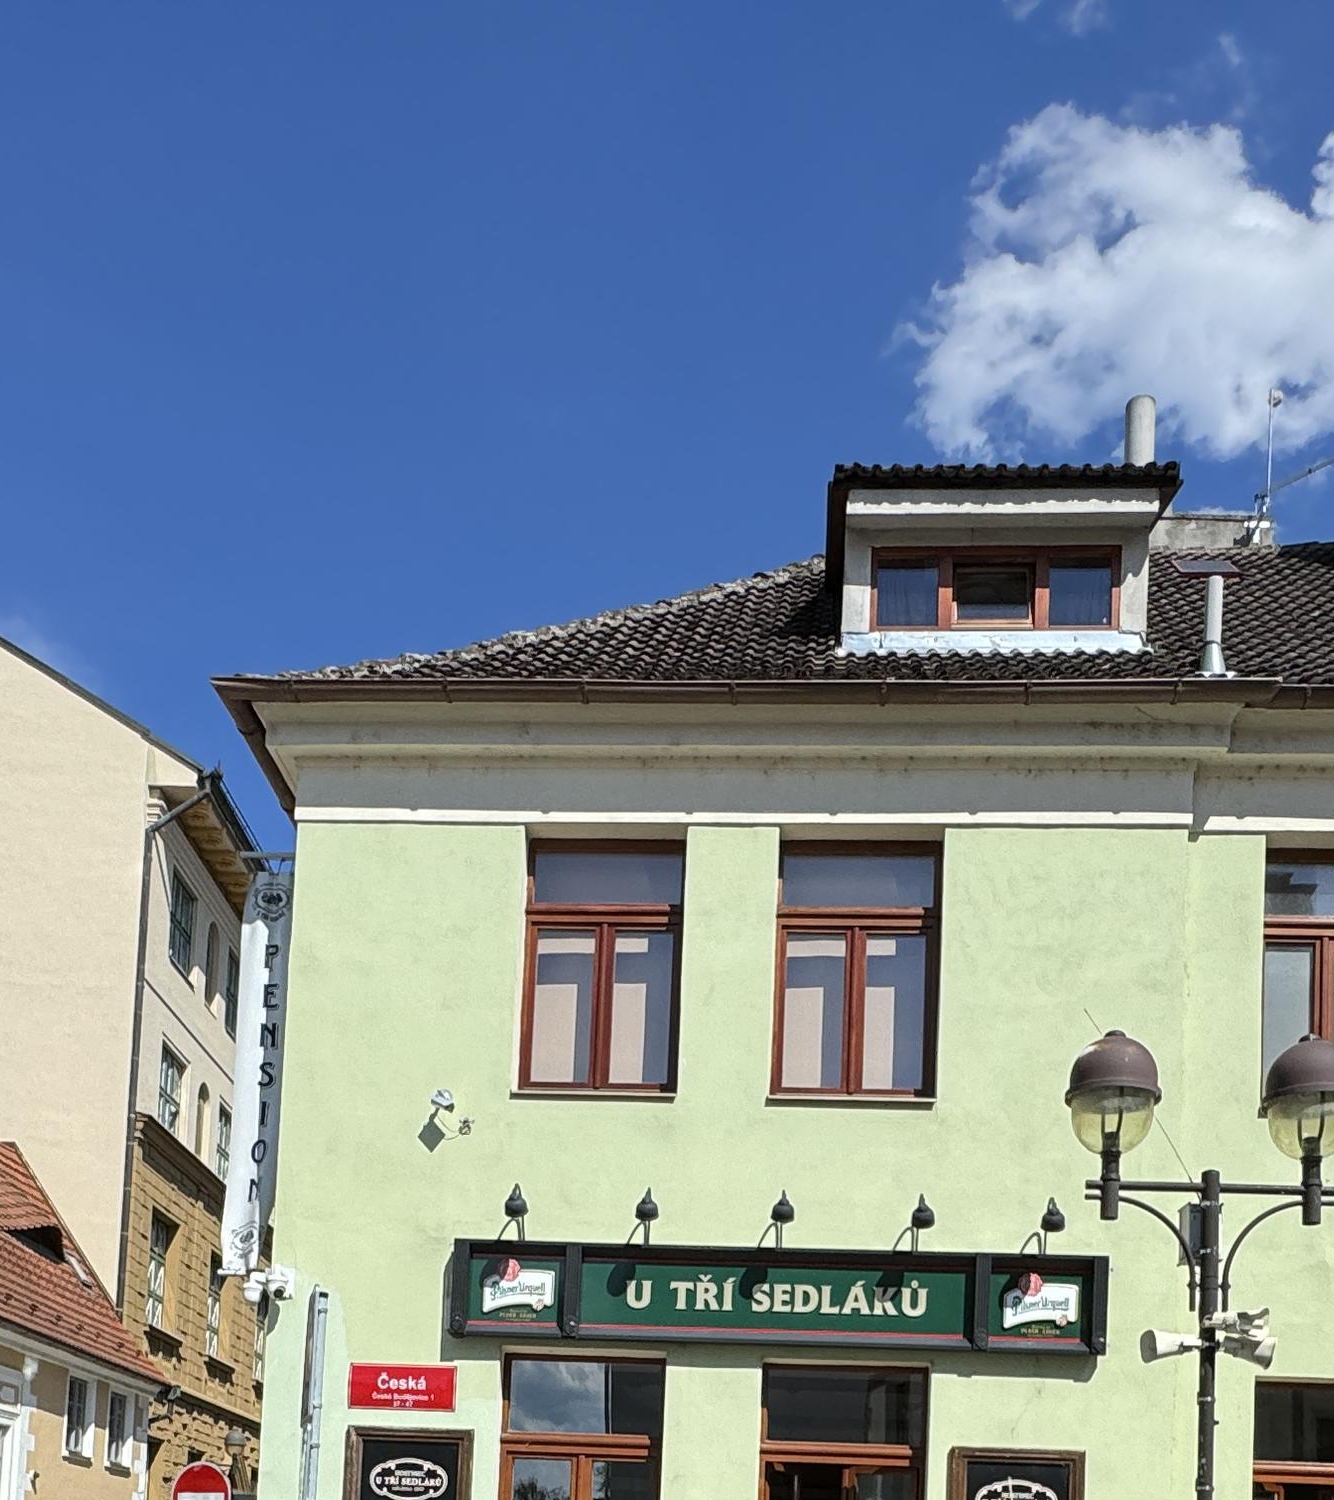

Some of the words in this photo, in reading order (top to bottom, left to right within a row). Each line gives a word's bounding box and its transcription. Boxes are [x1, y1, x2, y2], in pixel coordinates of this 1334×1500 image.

[249, 942, 281, 1204] PENSION
[625, 1279, 652, 1309] U
[669, 1273, 737, 1312] TŘÍ
[750, 1279, 930, 1318] SEDLÁKŮ
[377, 1371, 427, 1391] Česká
